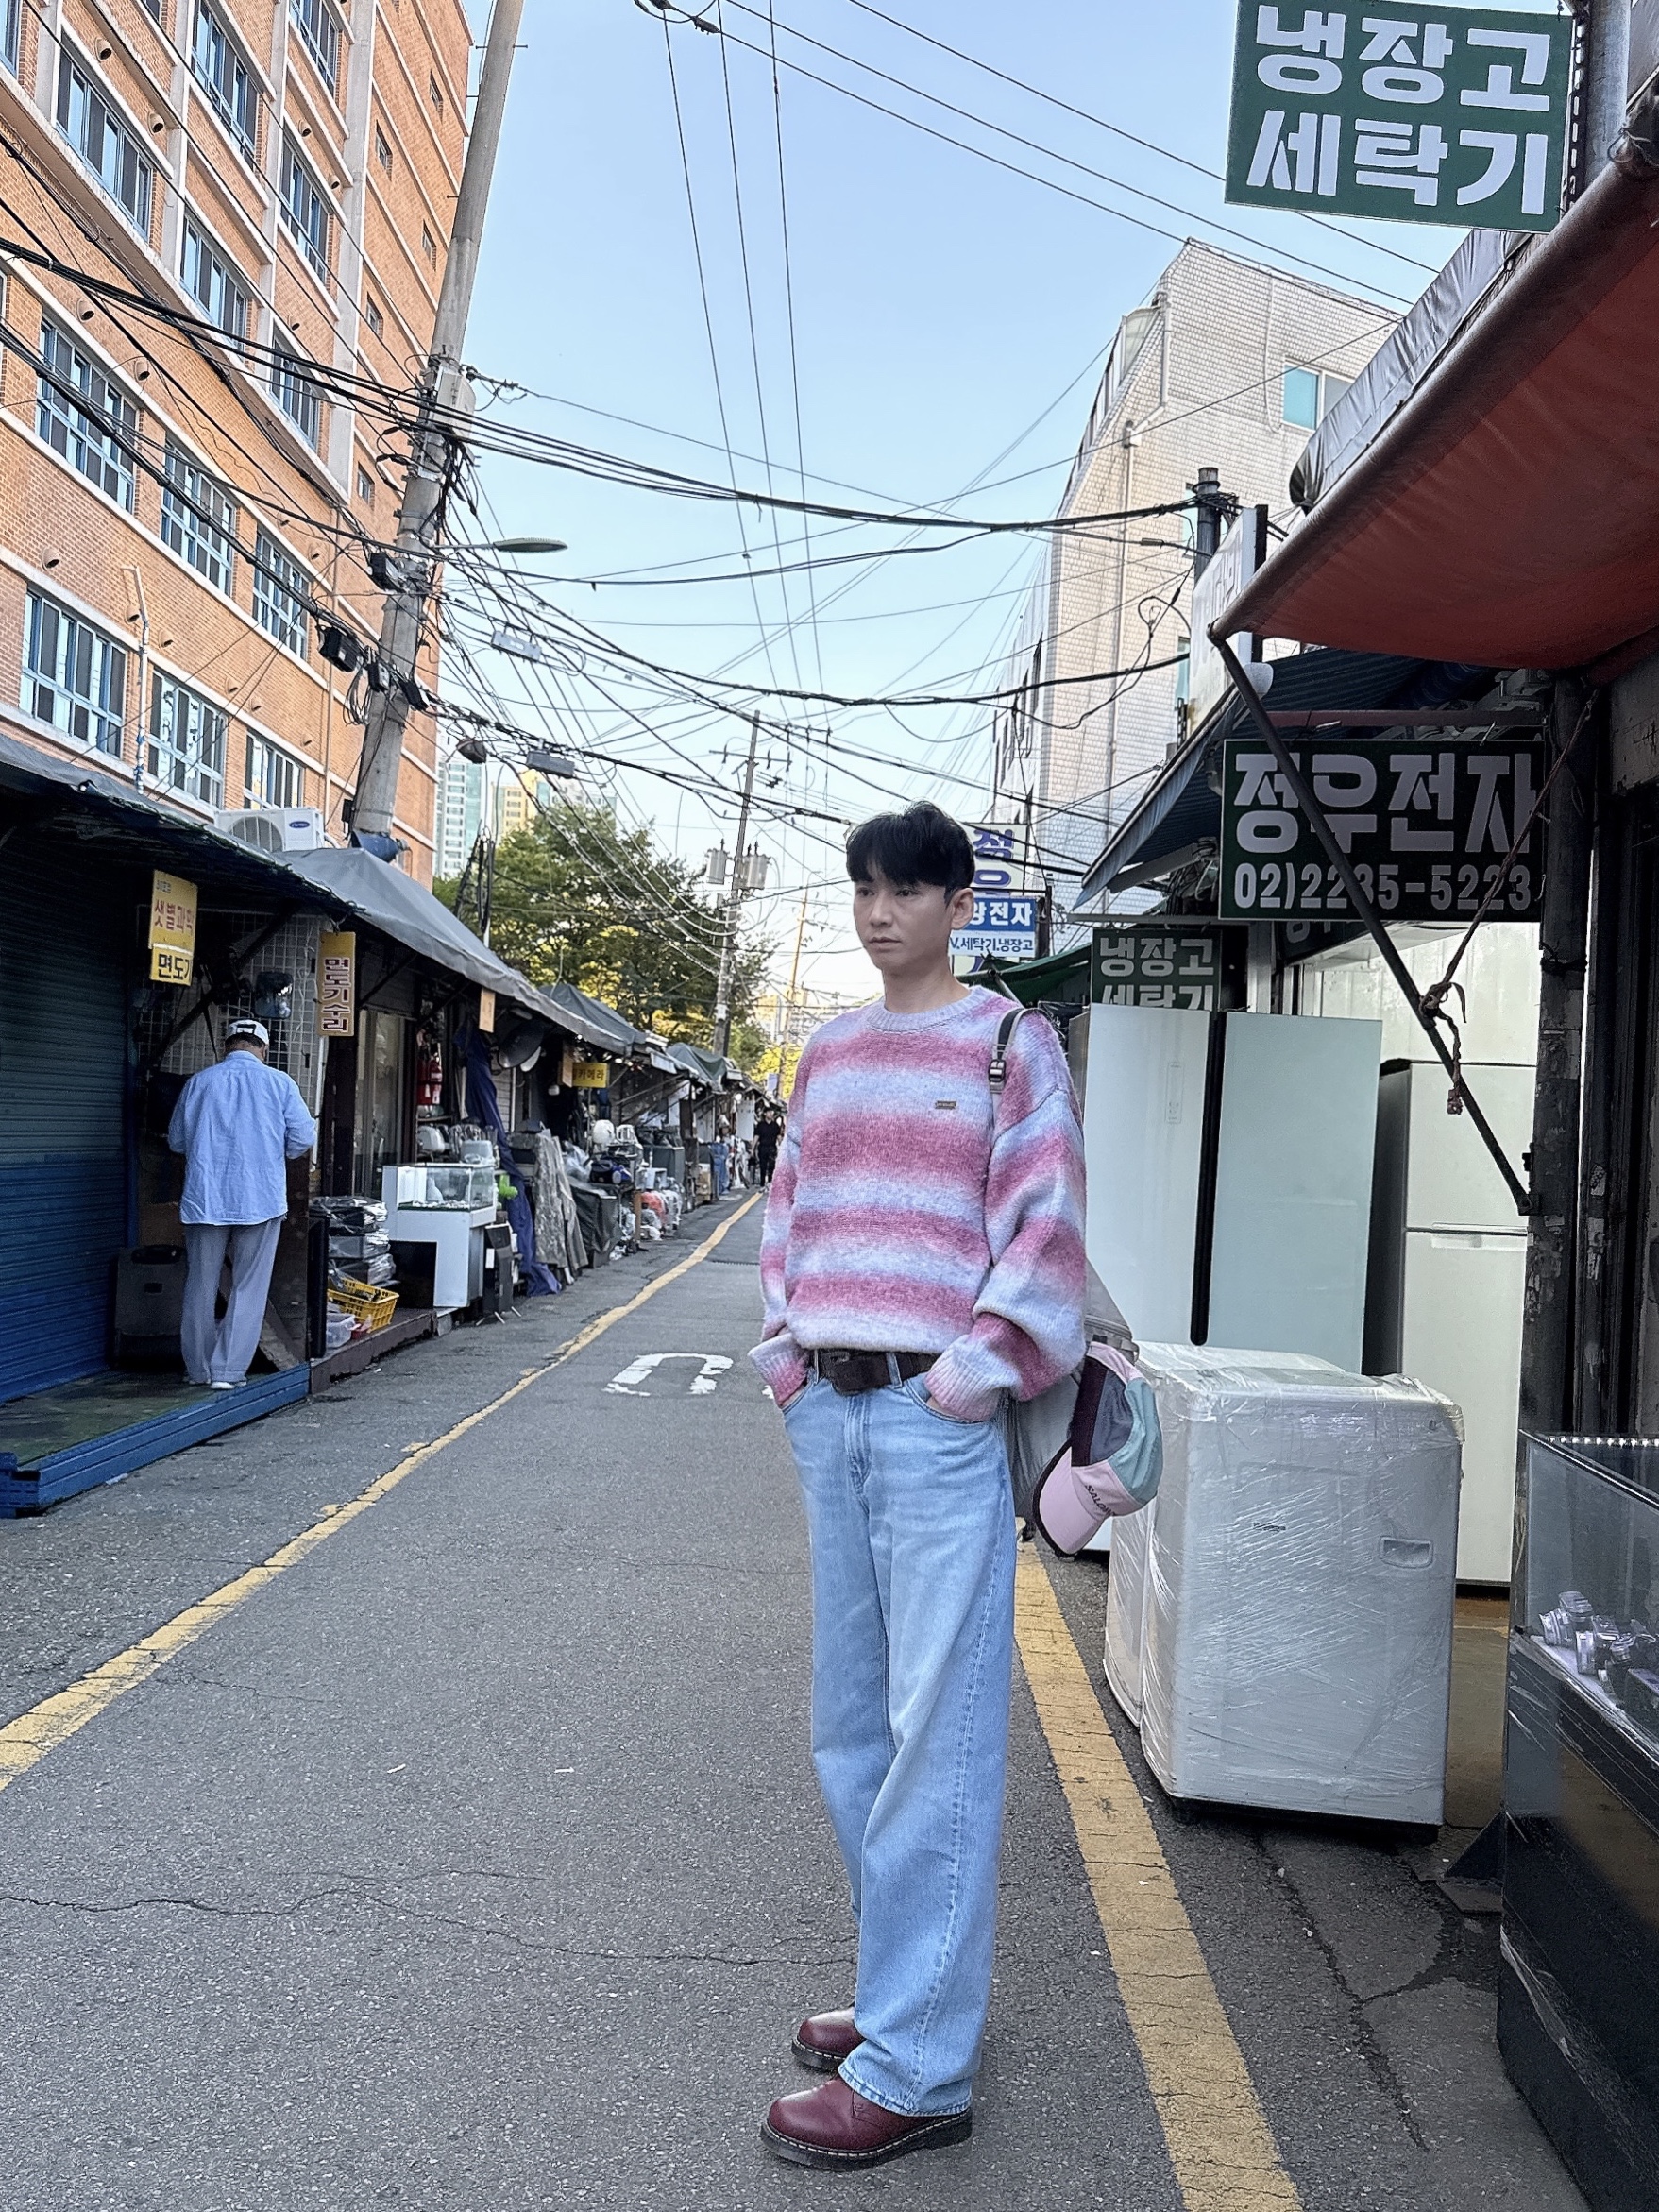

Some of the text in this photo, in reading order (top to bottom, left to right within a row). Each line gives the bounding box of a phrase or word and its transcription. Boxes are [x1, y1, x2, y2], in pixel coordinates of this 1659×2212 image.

[1256, 4, 1551, 112] 냉장고
[1246, 109, 1549, 215] 세탁기
[1233, 752, 1537, 854] 정우전자
[1234, 861, 1532, 910] 02)2235-5223
[1099, 937, 1215, 977] 냉장고
[572, 1069, 604, 1081] 카메라
